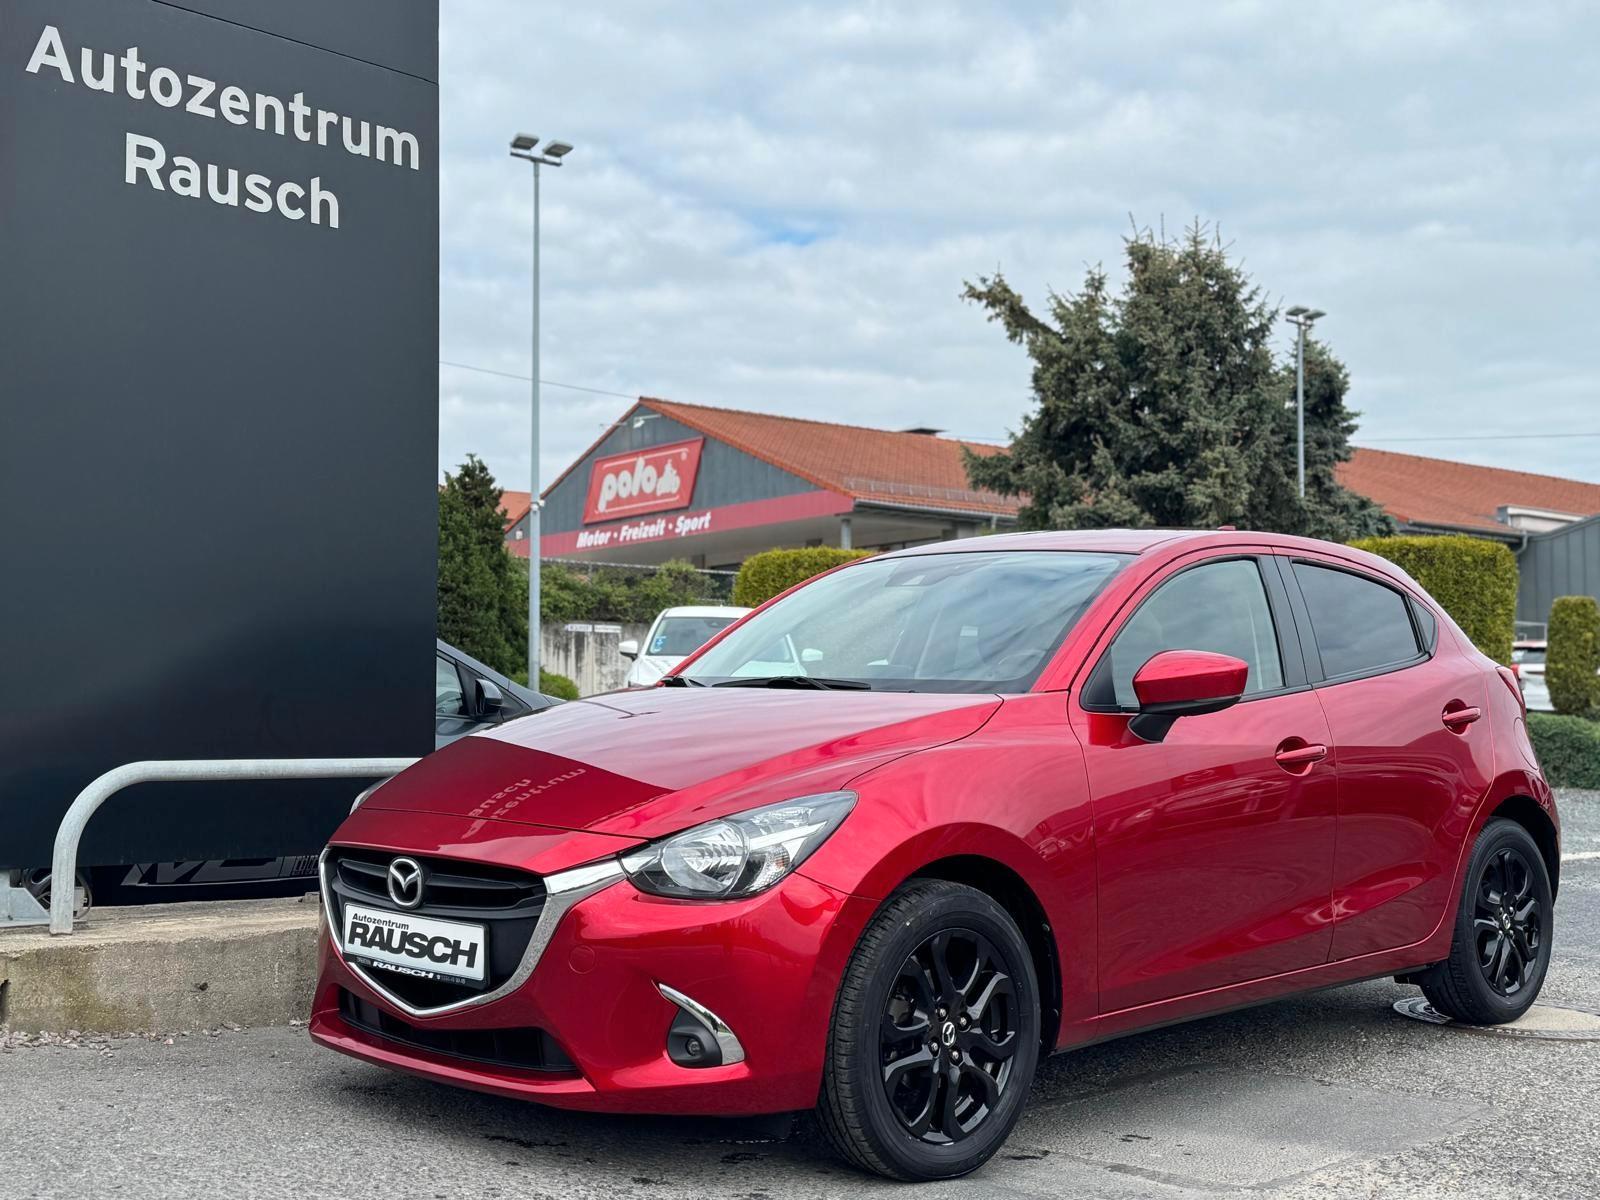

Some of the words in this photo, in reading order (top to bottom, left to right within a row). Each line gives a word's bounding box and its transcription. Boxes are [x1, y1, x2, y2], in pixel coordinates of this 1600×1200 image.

[25, 25, 420, 170] Autozentrum
[125, 132, 340, 229] Rausch
[597, 456, 658, 513] polo
[575, 531, 612, 549] Motor
[619, 518, 666, 541] Freizeit
[674, 512, 711, 537] Sport
[348, 921, 479, 969] RAUSCH
[352, 913, 410, 931] Autozentrum
[372, 961, 434, 979] RAUSCH
